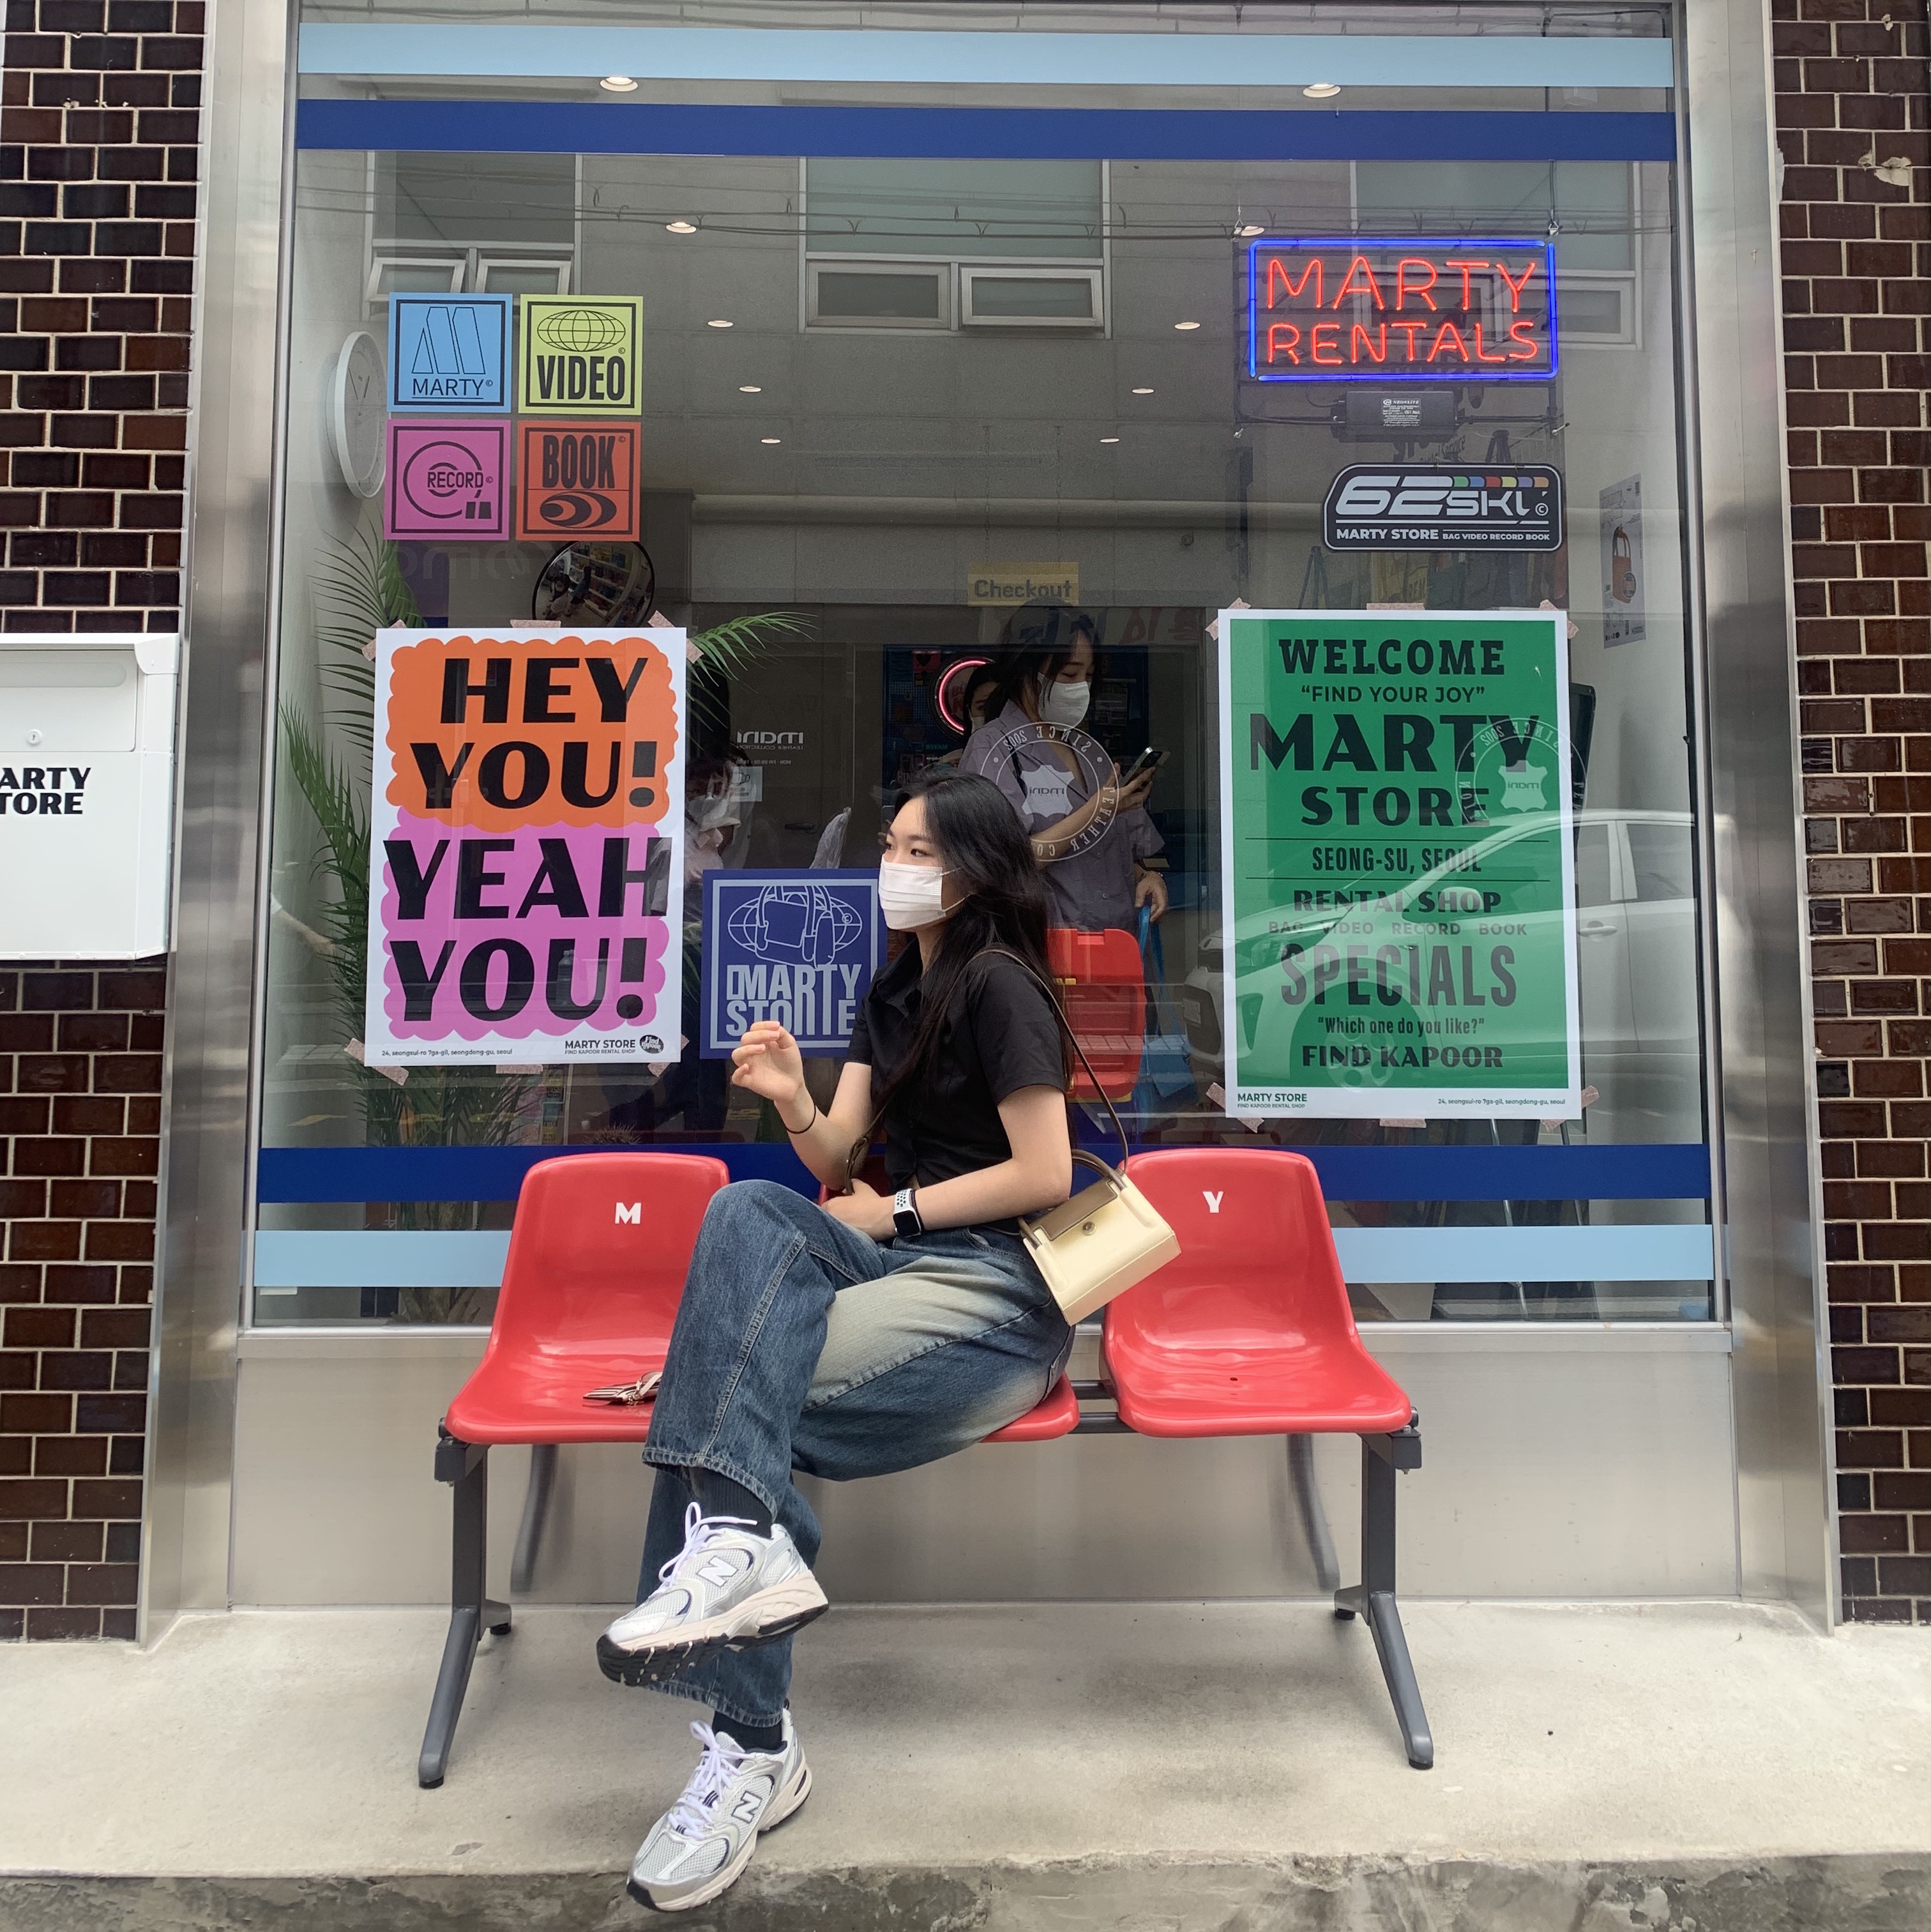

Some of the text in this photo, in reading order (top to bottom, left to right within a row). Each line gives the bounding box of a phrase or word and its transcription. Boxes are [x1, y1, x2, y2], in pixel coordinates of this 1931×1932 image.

[1267, 255, 1536, 312] MARTY
[1267, 322, 1538, 365] RENTALS
[412, 378, 484, 396] MARTY
[536, 355, 625, 400] VIDEO
[542, 434, 616, 489] BOOK
[427, 471, 483, 489] RECORD
[1337, 529, 1388, 540] MARTY
[1391, 529, 1439, 540] STORE
[974, 579, 1072, 598] Checkout
[1278, 639, 1504, 675] WELCOME
[440, 657, 648, 724] HEY
[1301, 685, 1485, 703] “FIND YOUR JOY”
[1250, 713, 1540, 772] MARTY
[0, 767, 91, 789] ARTY
[409, 741, 657, 809] YOU!
[0, 793, 84, 814] TORE
[1301, 786, 1490, 828] STORE
[1312, 847, 1481, 874] SEONG-SU, SEOUL
[382, 837, 672, 920] YEAH
[1294, 890, 1501, 913] RENTAL SHOP
[1268, 921, 1528, 936] BAG VIDEO RECORD BOOK
[390, 937, 647, 1022] YOU!
[1281, 943, 1517, 1007] SPECIALS
[1370, 1020, 1393, 1034] one
[1398, 1018, 1413, 1034] do
[1418, 1021, 1441, 1037] you
[565, 1039, 636, 1049] MARTY STORE
[1302, 1046, 1503, 1067] FIND KAPOOR
[1238, 1093, 1307, 1102] MARTY STORE
[614, 1202, 642, 1224] M
[1202, 1190, 1224, 1213] Y
[697, 1555, 738, 1587] N
[731, 1790, 763, 1823] N
